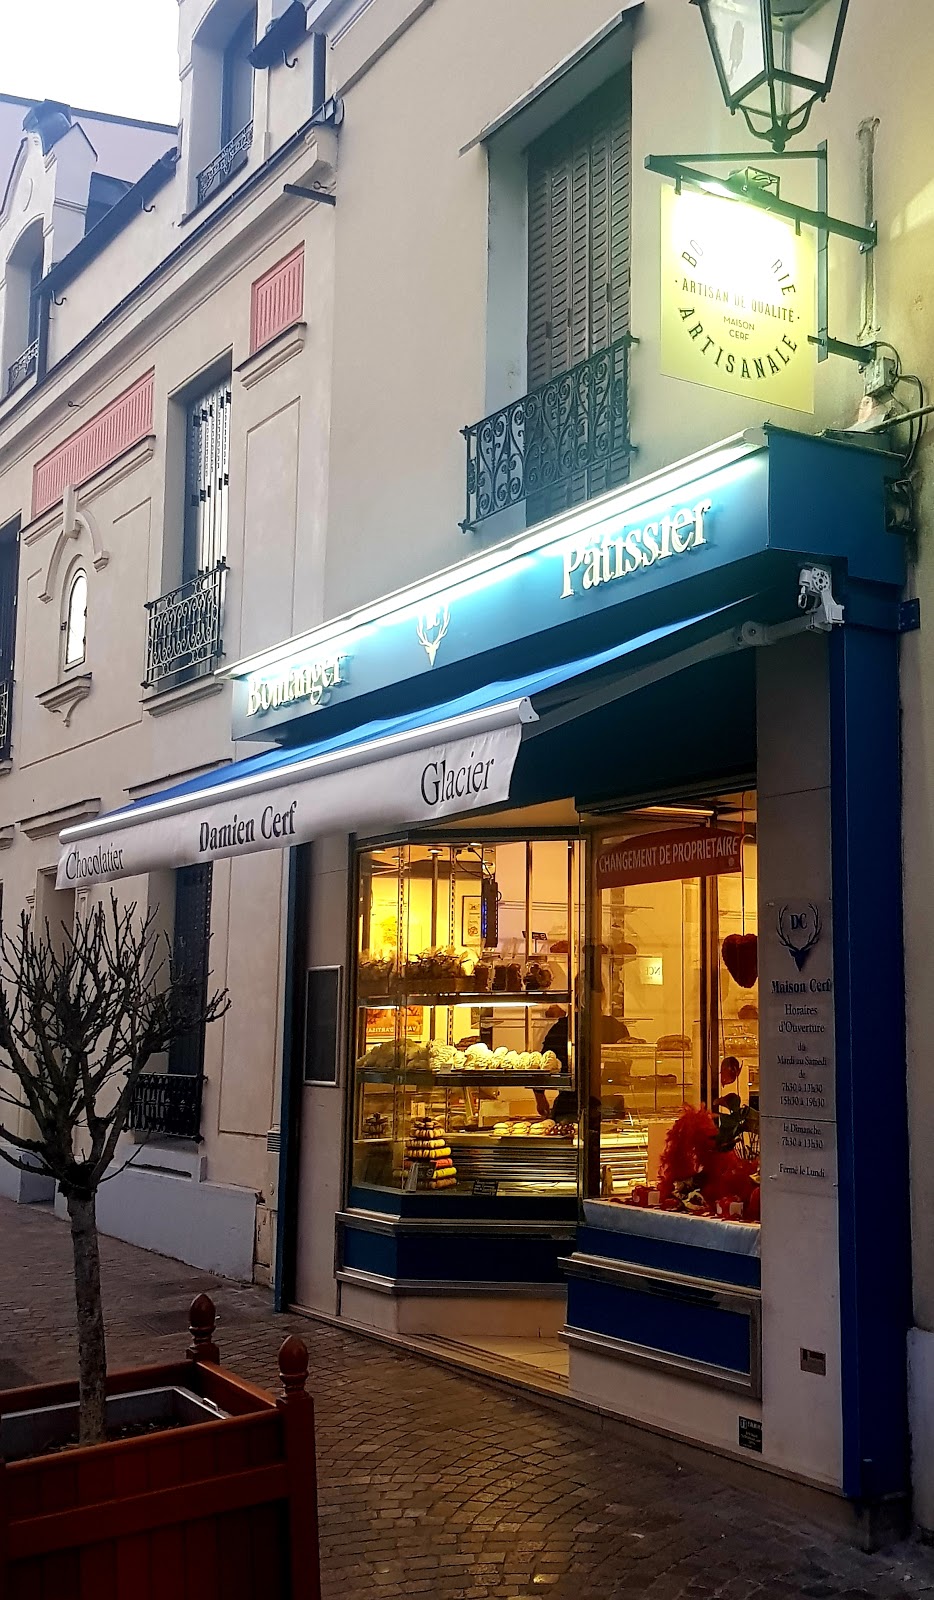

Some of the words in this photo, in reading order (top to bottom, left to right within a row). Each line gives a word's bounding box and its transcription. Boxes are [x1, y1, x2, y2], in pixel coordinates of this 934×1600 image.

[682, 278, 729, 303] ARTISAN
[752, 299, 795, 323] QUALITÉ
[723, 315, 755, 331] MAISON
[729, 329, 750, 341] CERF
[678, 306, 798, 380] ARTISANALE
[246, 655, 344, 717] Boulanger
[421, 756, 495, 807] Glacier
[199, 819, 256, 853] Damien
[260, 800, 298, 841] Cerf
[600, 846, 658, 873] CHANGEMENT
[659, 844, 671, 865] DE
[672, 836, 740, 862] PROPRIETAIRE
[65, 842, 125, 881] Chocolatier
[790, 913, 807, 930] DC
[772, 981, 806, 993] Maison
[809, 979, 832, 992] Cerf
[784, 1004, 818, 1015] Horaires
[778, 1021, 825, 1033] d'Ouverture
[797, 1043, 806, 1051] du
[777, 1056, 795, 1065] Mardi
[805, 1056, 827, 1065] Samedi
[782, 1082, 797, 1092] 7h30
[780, 1096, 799, 1106] 15h30
[790, 1123, 822, 1135] Dimanche
[782, 1137, 797, 1147] 7h30
[779, 1164, 798, 1174] Fermé
[799, 1166, 806, 1175] le
[806, 1167, 826, 1177] Lundi
